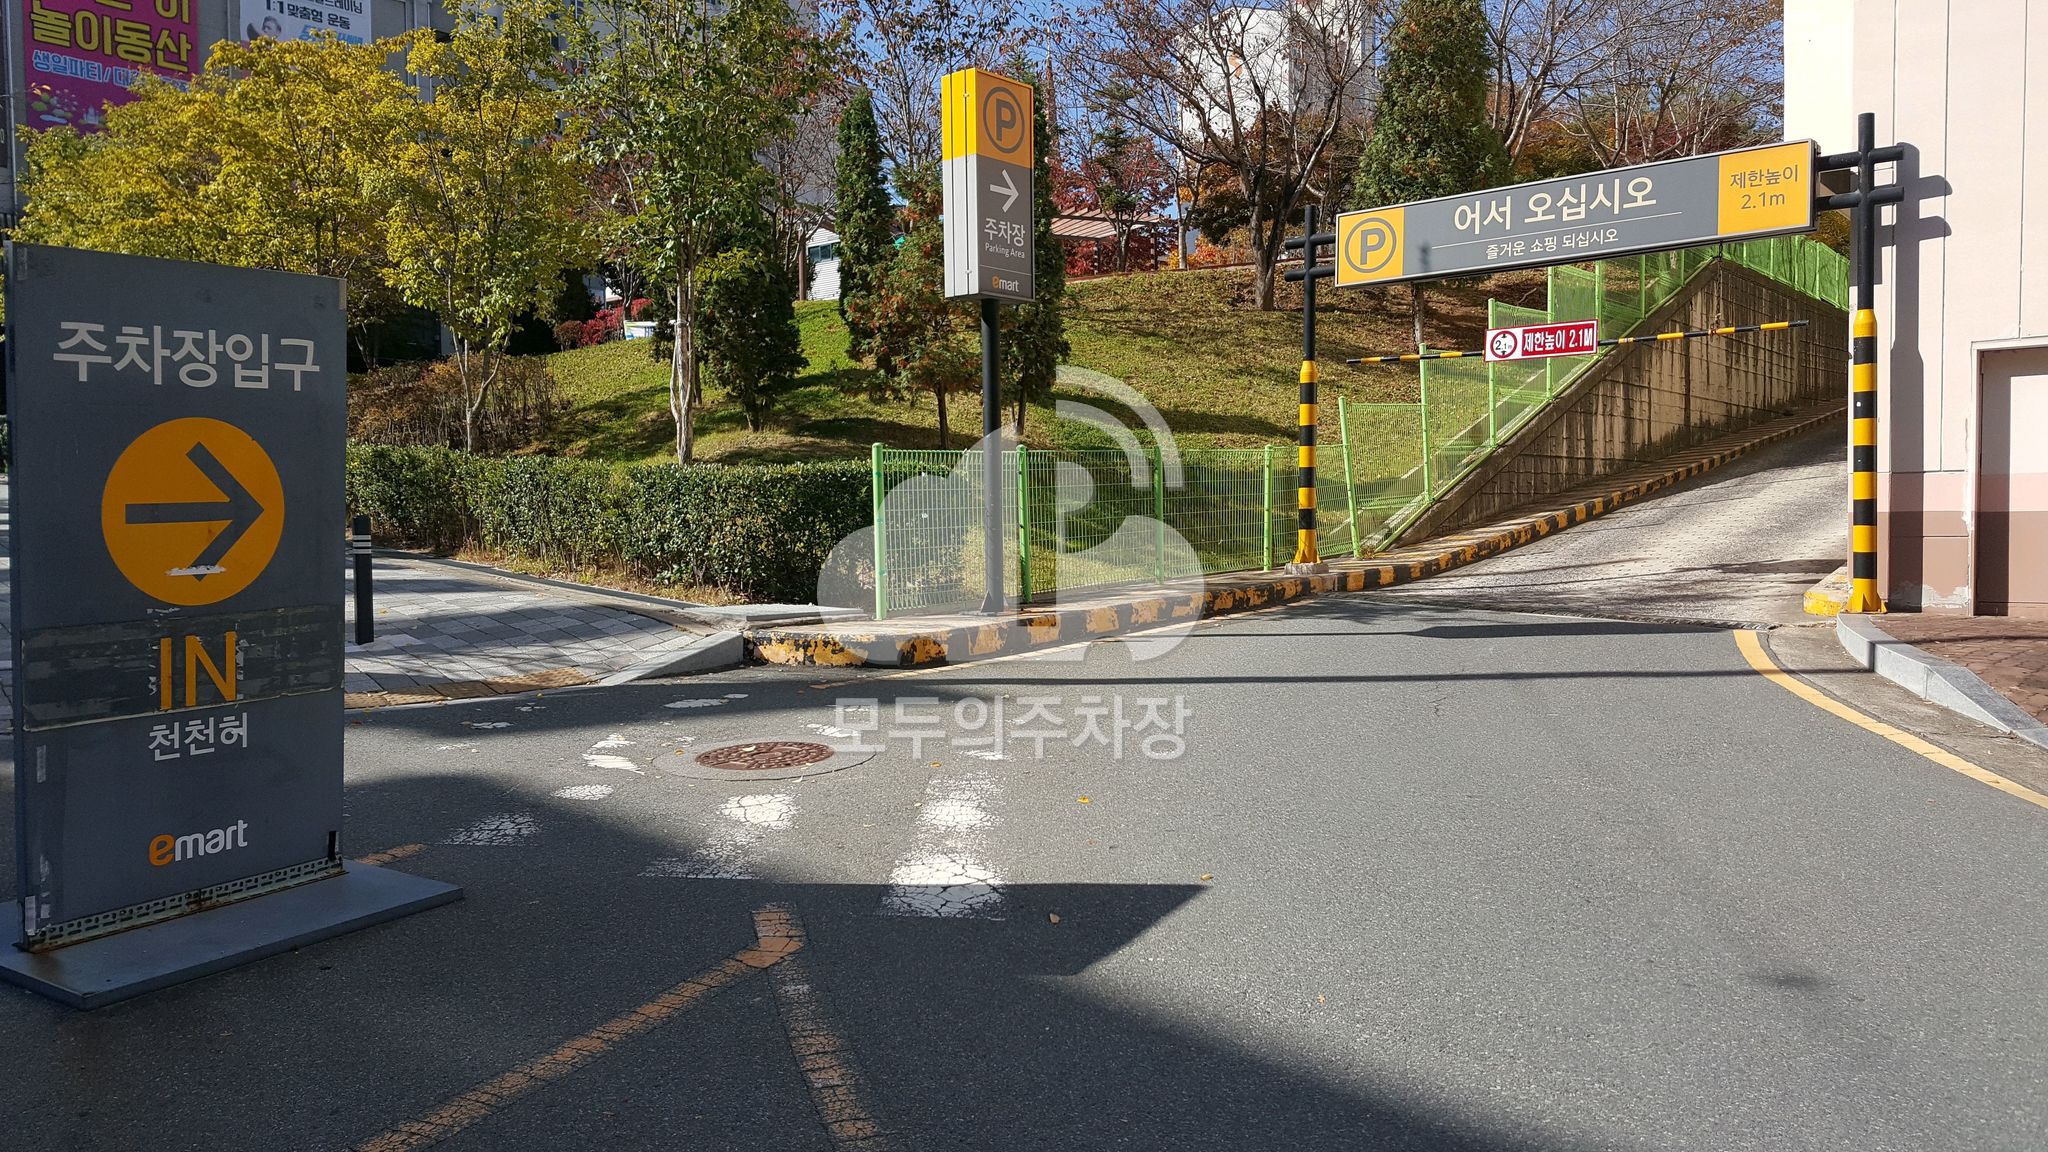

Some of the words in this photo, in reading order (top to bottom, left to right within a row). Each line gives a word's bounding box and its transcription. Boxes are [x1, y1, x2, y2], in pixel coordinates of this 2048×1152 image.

[30, 0, 192, 73] 놀이동산
[327, 13, 351, 30] 운동
[1729, 163, 1800, 189] 제한높이
[1453, 193, 1511, 235] 어서
[1524, 176, 1658, 225] 오십시오
[1740, 191, 1786, 210] 2.1m
[984, 217, 1026, 247] 주차장
[1486, 238, 1526, 259] 즐거운
[1530, 234, 1557, 253] 쇼핑
[1562, 228, 1620, 249] 되십시오
[985, 242, 1010, 257] Parking
[1010, 250, 1025, 260] Area
[991, 275, 1019, 293] emart
[1523, 329, 1566, 353] 제한높이
[1569, 328, 1593, 348] 2.1M
[52, 321, 321, 392] 주차장입구
[159, 630, 238, 711] IN
[148, 819, 249, 867] emart
